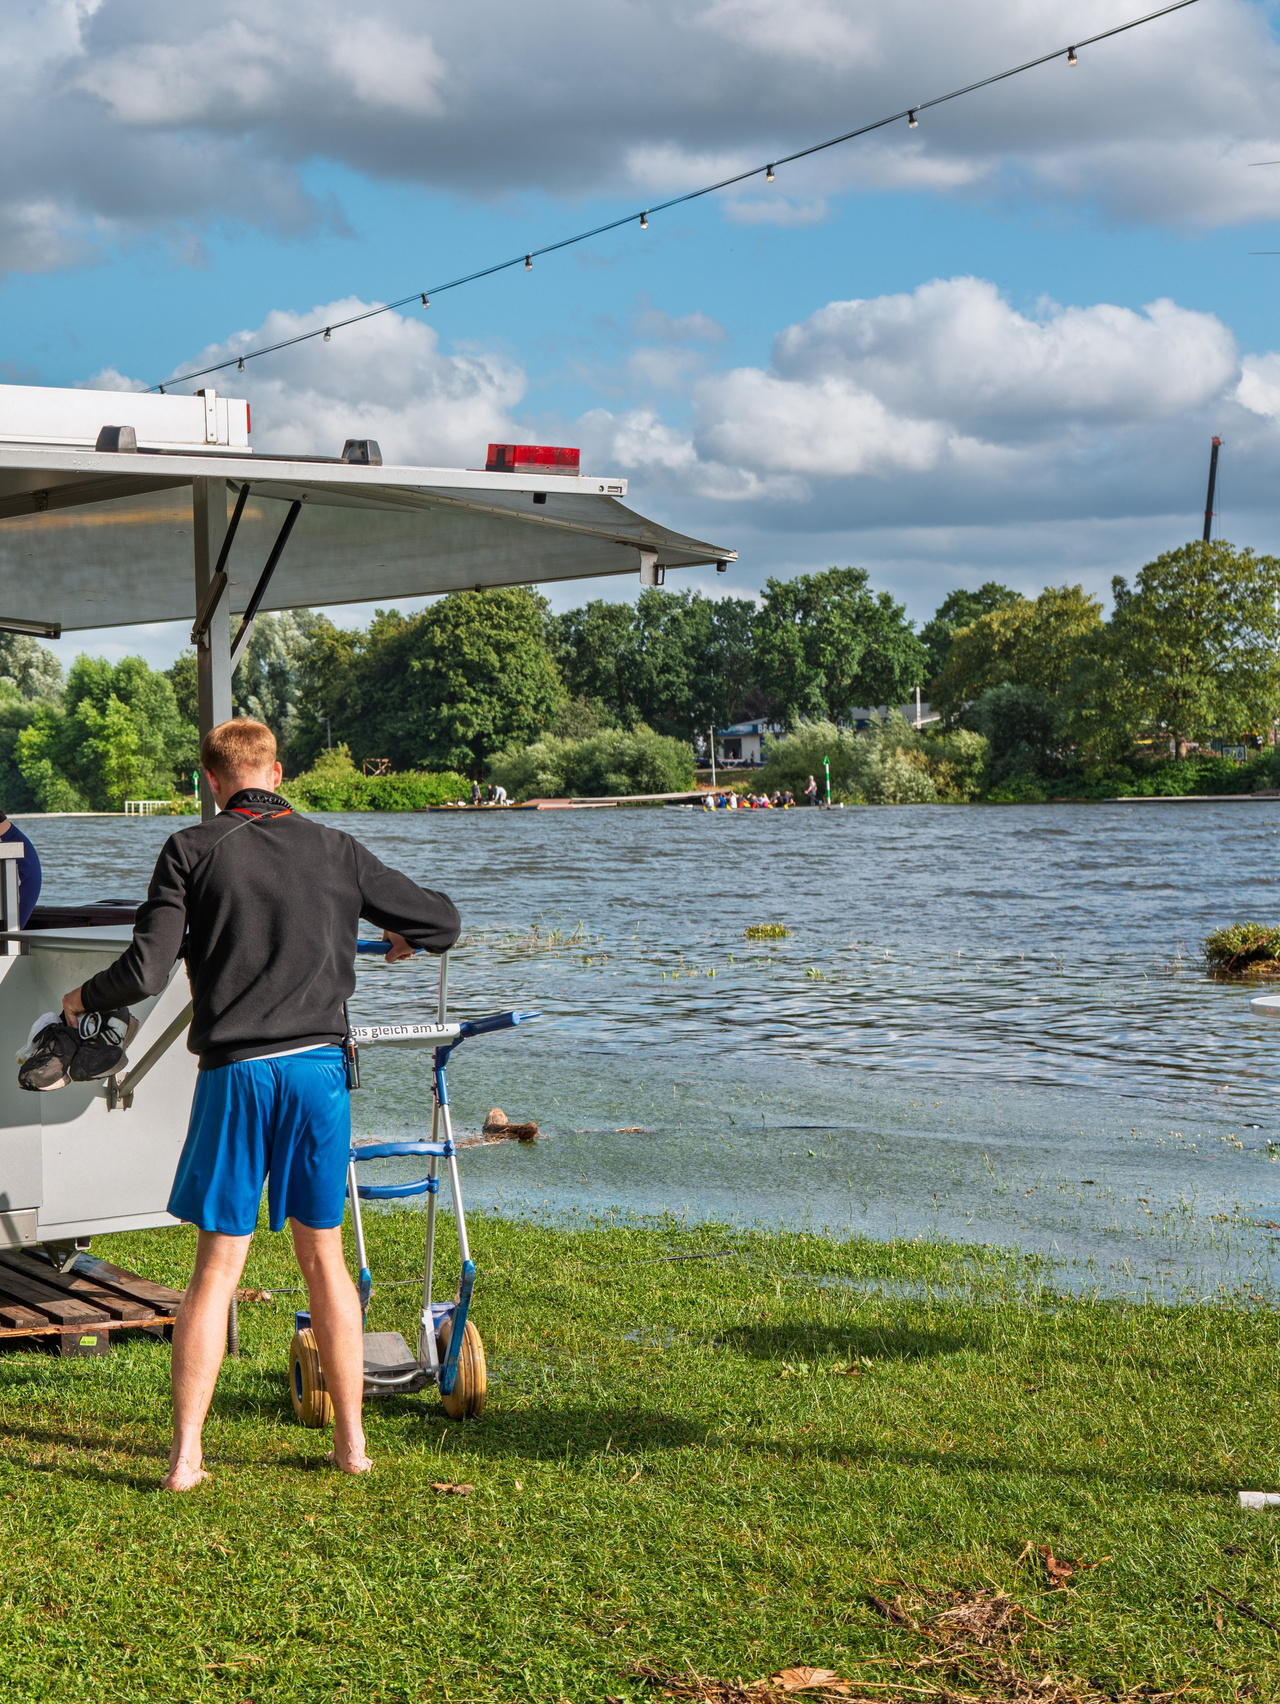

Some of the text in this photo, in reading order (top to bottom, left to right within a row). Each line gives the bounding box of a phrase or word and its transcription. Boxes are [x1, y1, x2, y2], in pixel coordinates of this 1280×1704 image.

[350, 1027, 368, 1037] Bis
[371, 1025, 408, 1039] gleich
[412, 1024, 432, 1034] am
